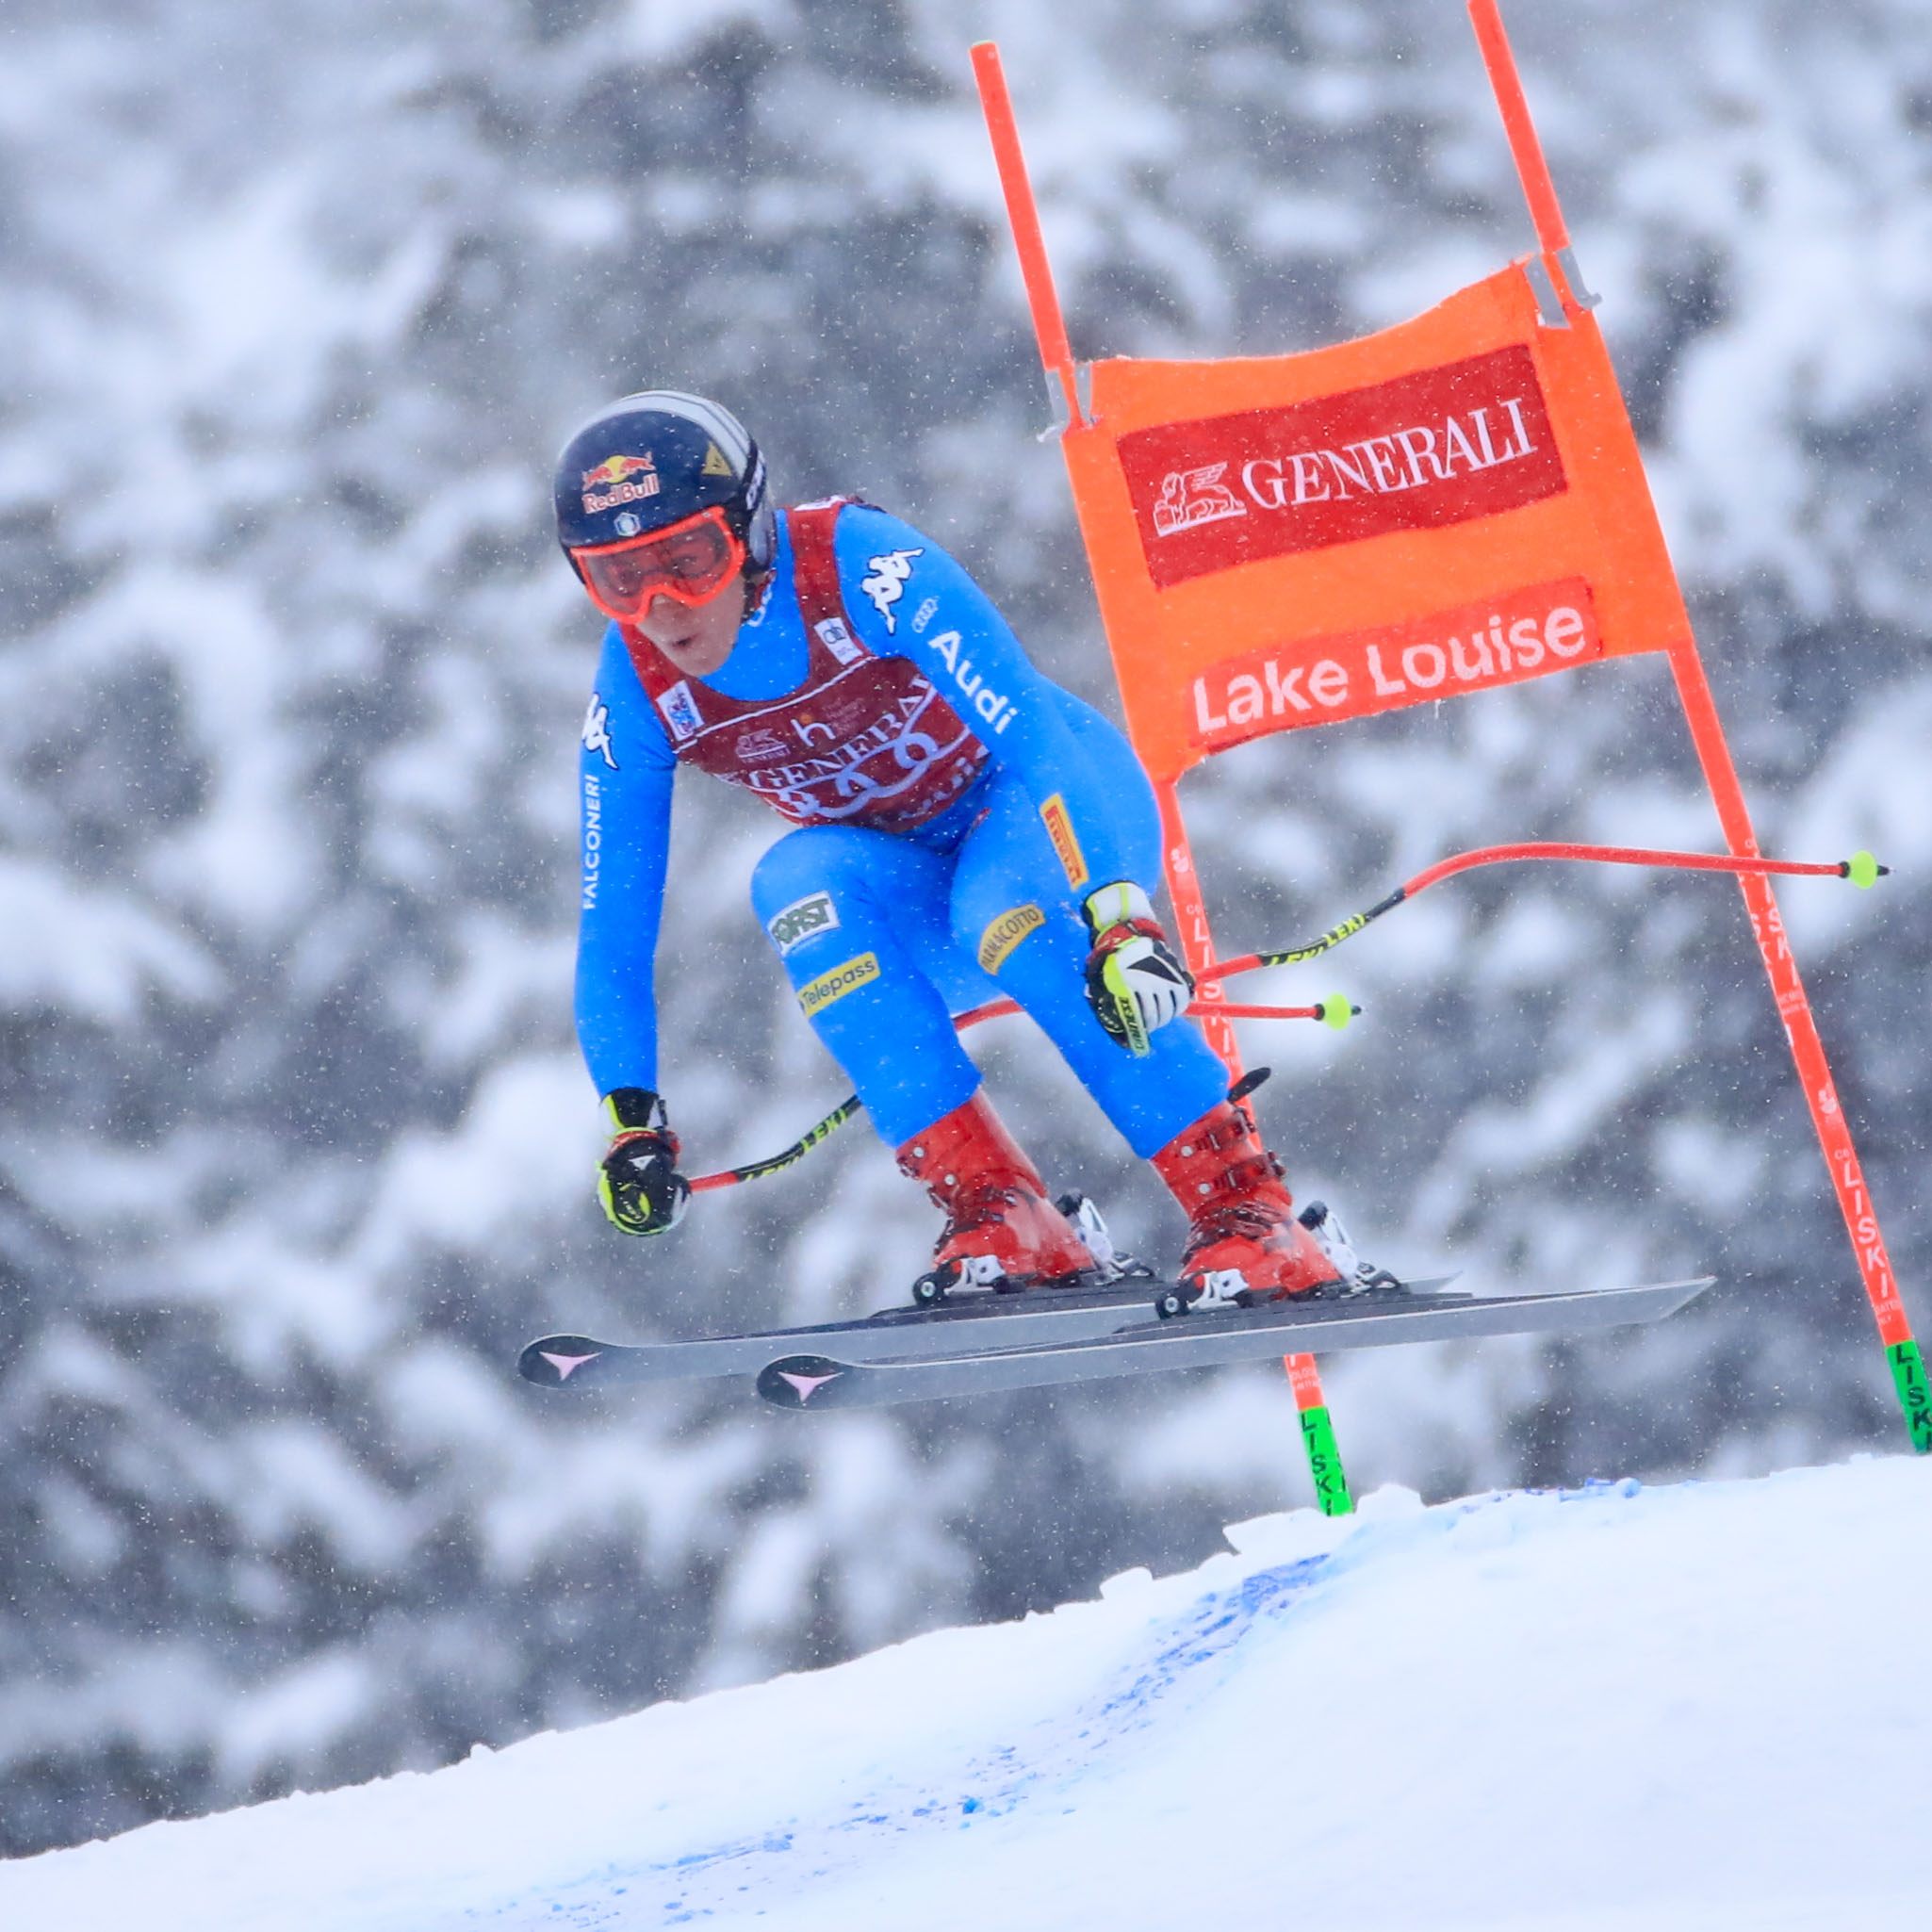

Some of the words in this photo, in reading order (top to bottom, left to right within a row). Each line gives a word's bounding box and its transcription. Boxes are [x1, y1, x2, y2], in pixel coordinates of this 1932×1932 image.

[1241, 398, 1538, 510] GENERALI
[927, 630, 1018, 734] Audi
[1192, 660, 1349, 734] Lake
[1366, 606, 1586, 696] Louise
[582, 774, 603, 909] FALCONERI
[802, 960, 876, 1007] Telepass
[1844, 1160, 1888, 1298] LISKI
[1301, 1413, 1334, 1516] LISKI
